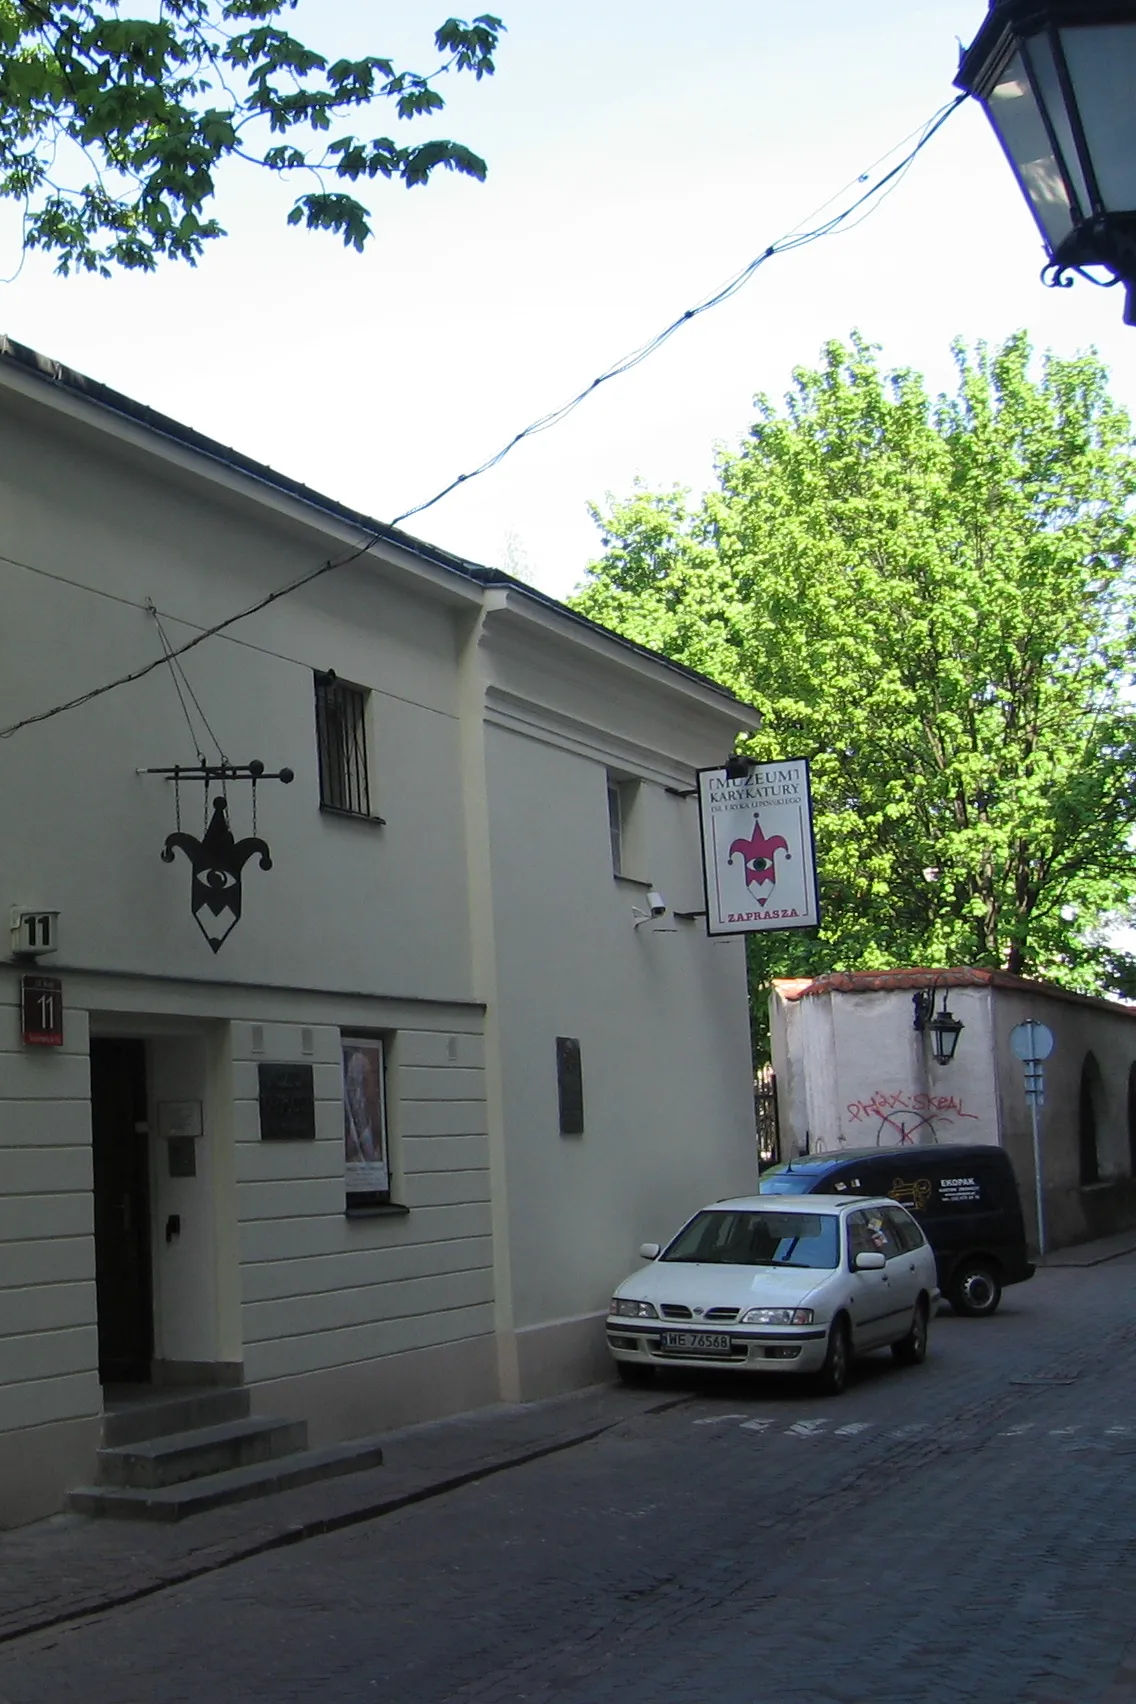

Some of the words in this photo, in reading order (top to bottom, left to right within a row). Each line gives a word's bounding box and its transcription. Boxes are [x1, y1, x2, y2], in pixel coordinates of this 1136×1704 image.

[710, 783, 800, 803] KARYKATURY
[728, 908, 799, 923] ZAPRASZA
[24, 915, 50, 946] 11
[37, 995, 54, 1029] 11
[940, 1177, 976, 1187] EKOPAK
[668, 1332, 686, 1346] WE
[690, 1334, 728, 1349] 76568
